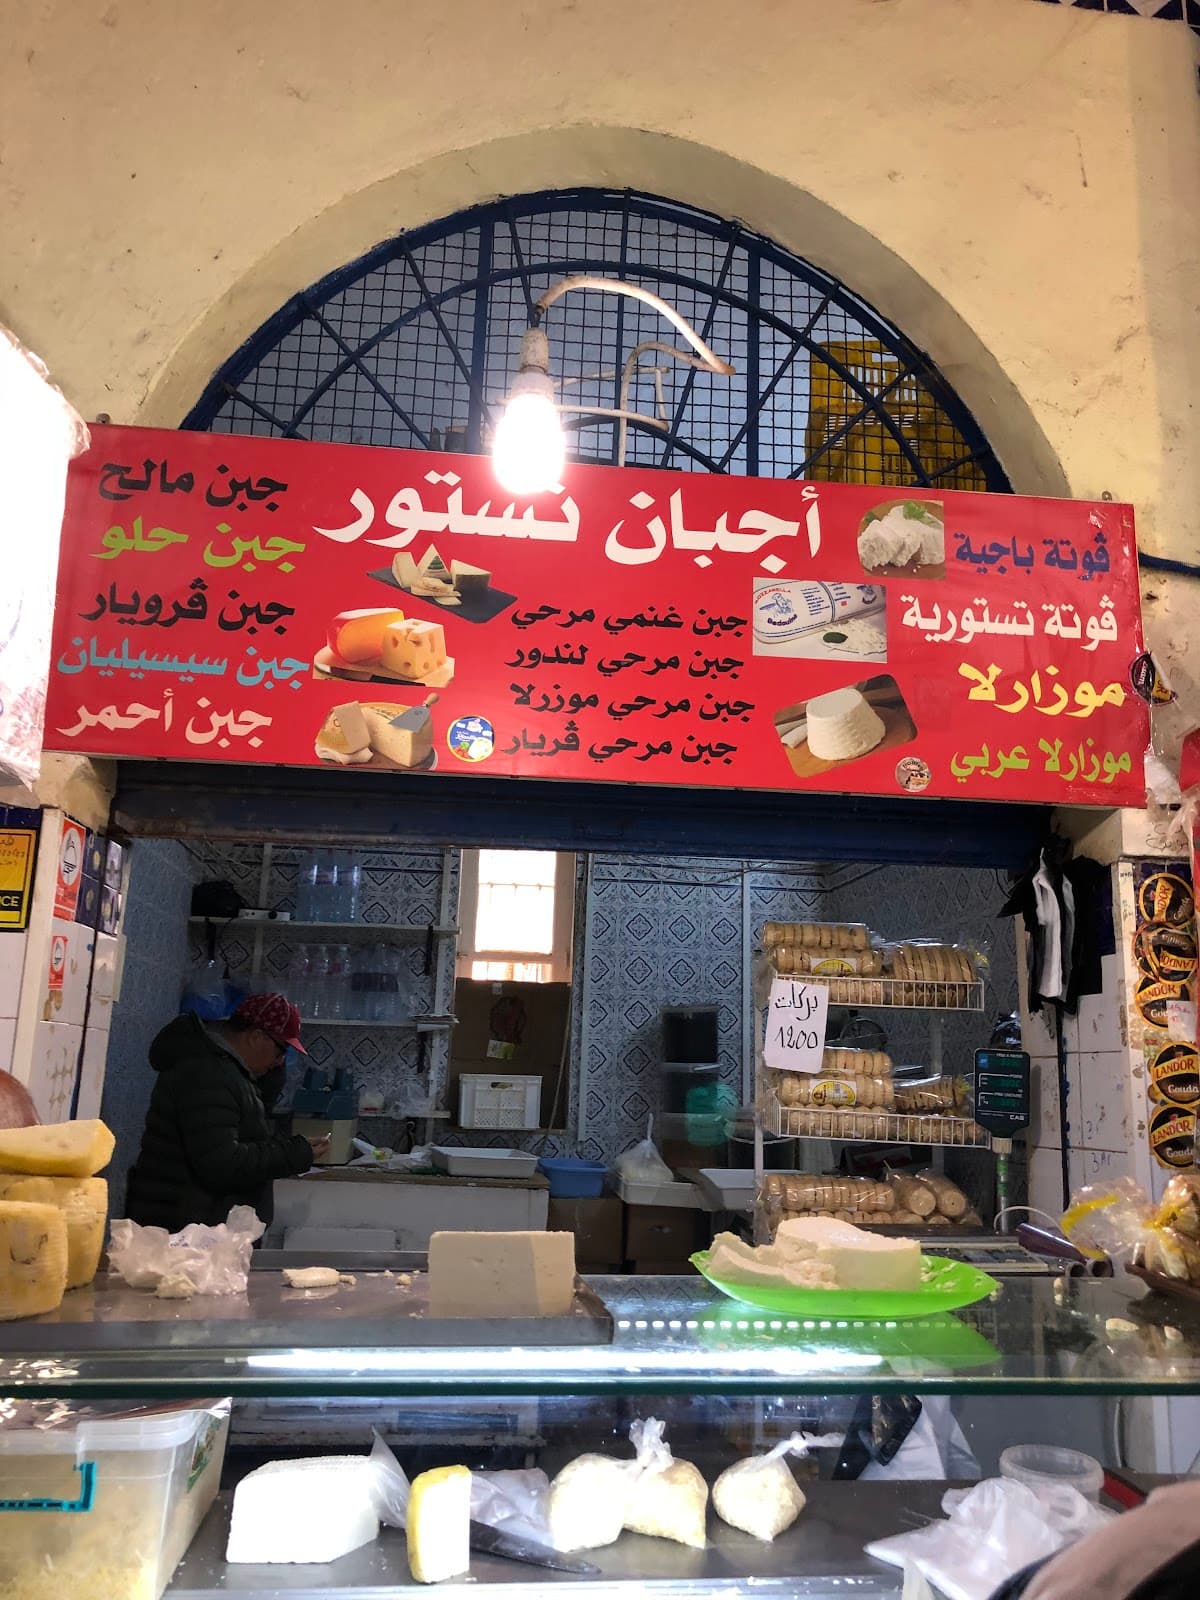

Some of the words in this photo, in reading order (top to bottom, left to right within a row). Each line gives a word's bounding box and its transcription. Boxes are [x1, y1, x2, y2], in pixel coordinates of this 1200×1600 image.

[98, 459, 194, 501] مالح
[205, 464, 288, 512] جبن
[89, 516, 188, 558] حلو
[605, 485, 822, 574] أجبان
[203, 523, 305, 572] جبن
[954, 533, 1034, 574] باجية
[218, 590, 295, 635] جبن
[511, 603, 595, 630] مرحي
[603, 606, 683, 635] غنمي
[693, 609, 747, 637] جبن
[901, 595, 1034, 643] تستورية
[57, 636, 227, 682] سيسيليان
[237, 646, 310, 690] جبن
[504, 643, 588, 669] لندور
[597, 652, 680, 677] مرحي
[688, 650, 744, 679] جبن
[510, 683, 599, 714] موزرلا
[958, 662, 1125, 717] موزارلا
[56, 688, 173, 736] أحمر
[185, 696, 272, 748] جبن
[608, 695, 690, 720] مرحي
[699, 693, 755, 722] جبن
[588, 737, 672, 763] مرحي
[681, 735, 737, 765] جبن
[951, 743, 1029, 782] عربي
[1039, 738, 1131, 783] موزارلا
[0, 896, 20, 907] CE
[1155, 1060, 1195, 1079] LANDOR
[1168, 1084, 1200, 1094] Gouda
[1153, 1120, 1192, 1144] LANDOR
